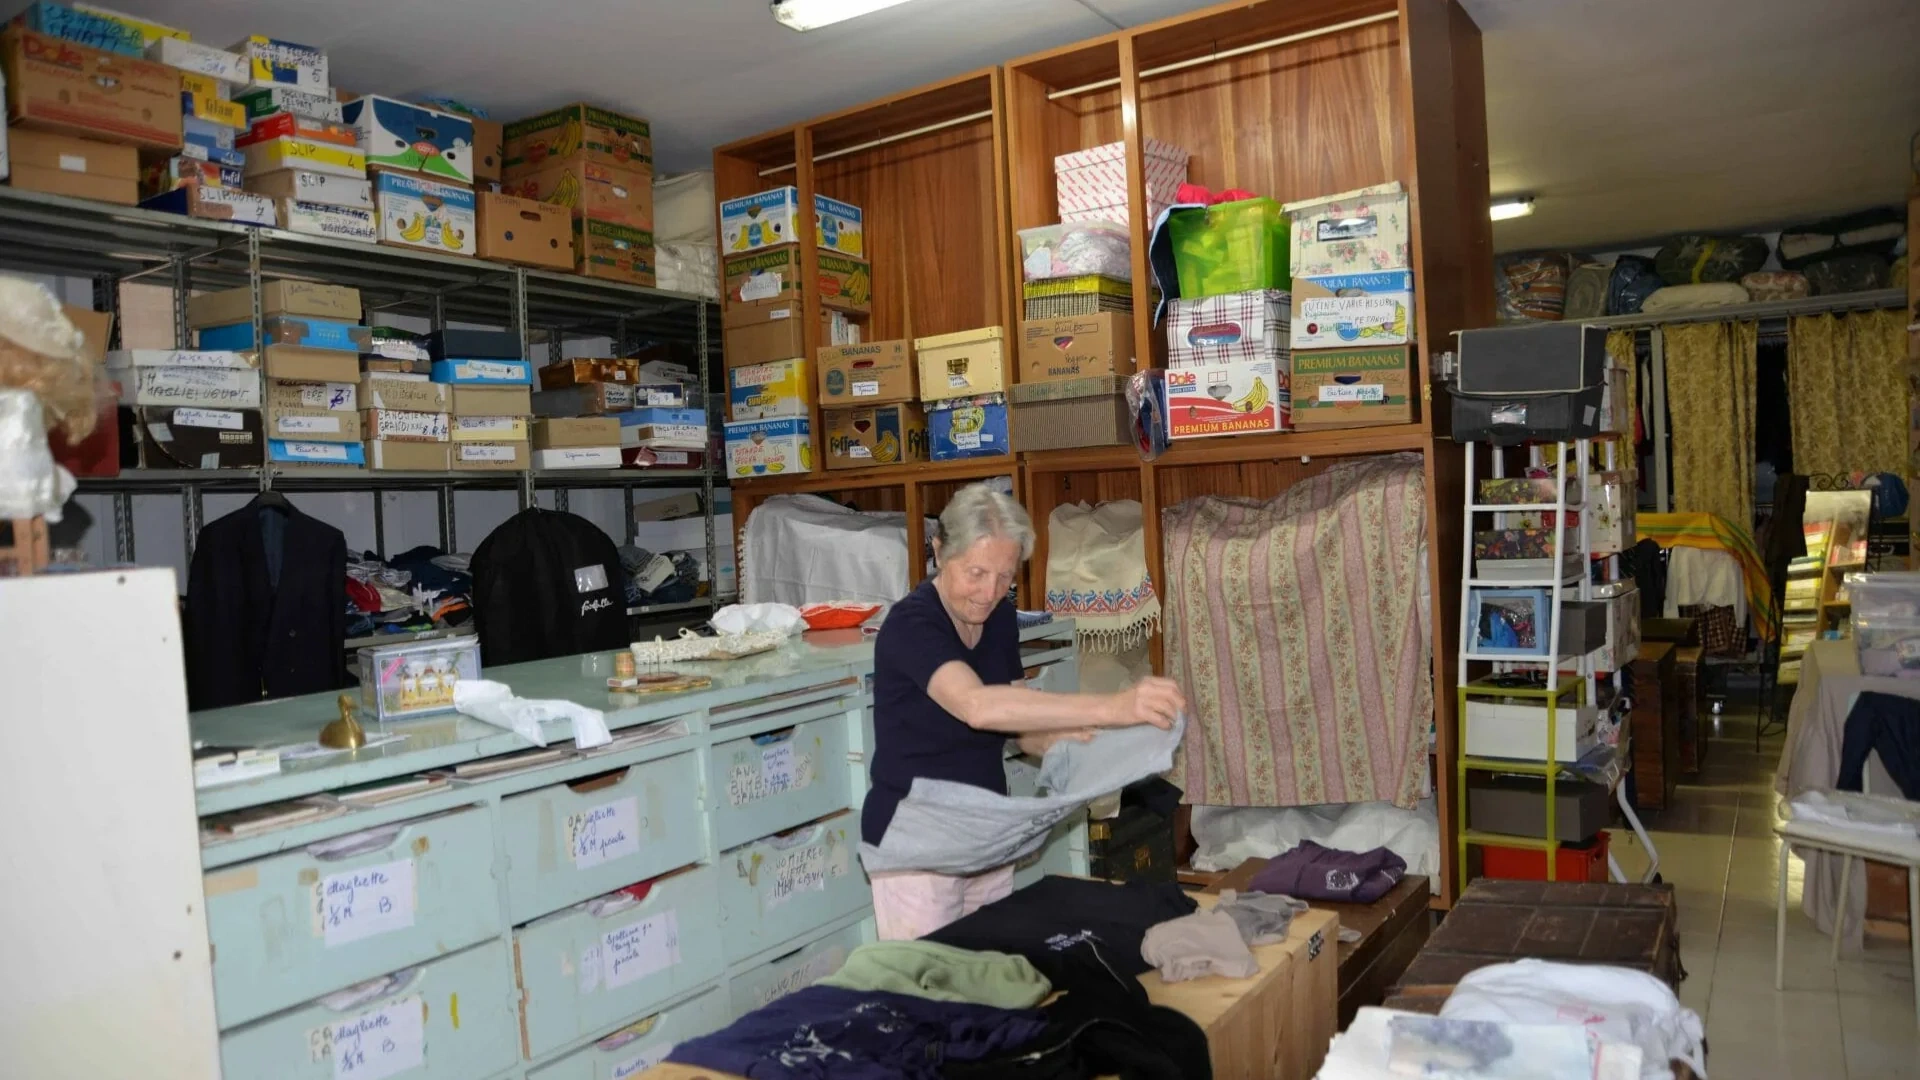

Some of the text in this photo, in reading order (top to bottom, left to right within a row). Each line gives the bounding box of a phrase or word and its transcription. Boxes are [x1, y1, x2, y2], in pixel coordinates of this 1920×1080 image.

[290, 142, 316, 156] SLIP
[300, 174, 326, 187] SLIP
[724, 192, 783, 212] PREMIUM BANANAS
[828, 203, 857, 218] BANANAS
[1352, 275, 1391, 287] BANANAS
[842, 345, 881, 356] BANANAS
[1298, 353, 1400, 370] PREMIUM BANANAS
[1048, 366, 1080, 376] BANANAS
[1168, 371, 1197, 385] Dole
[728, 421, 790, 435] PREMIUM BANANAS
[1174, 418, 1270, 435] PREMIUM BANANAS
